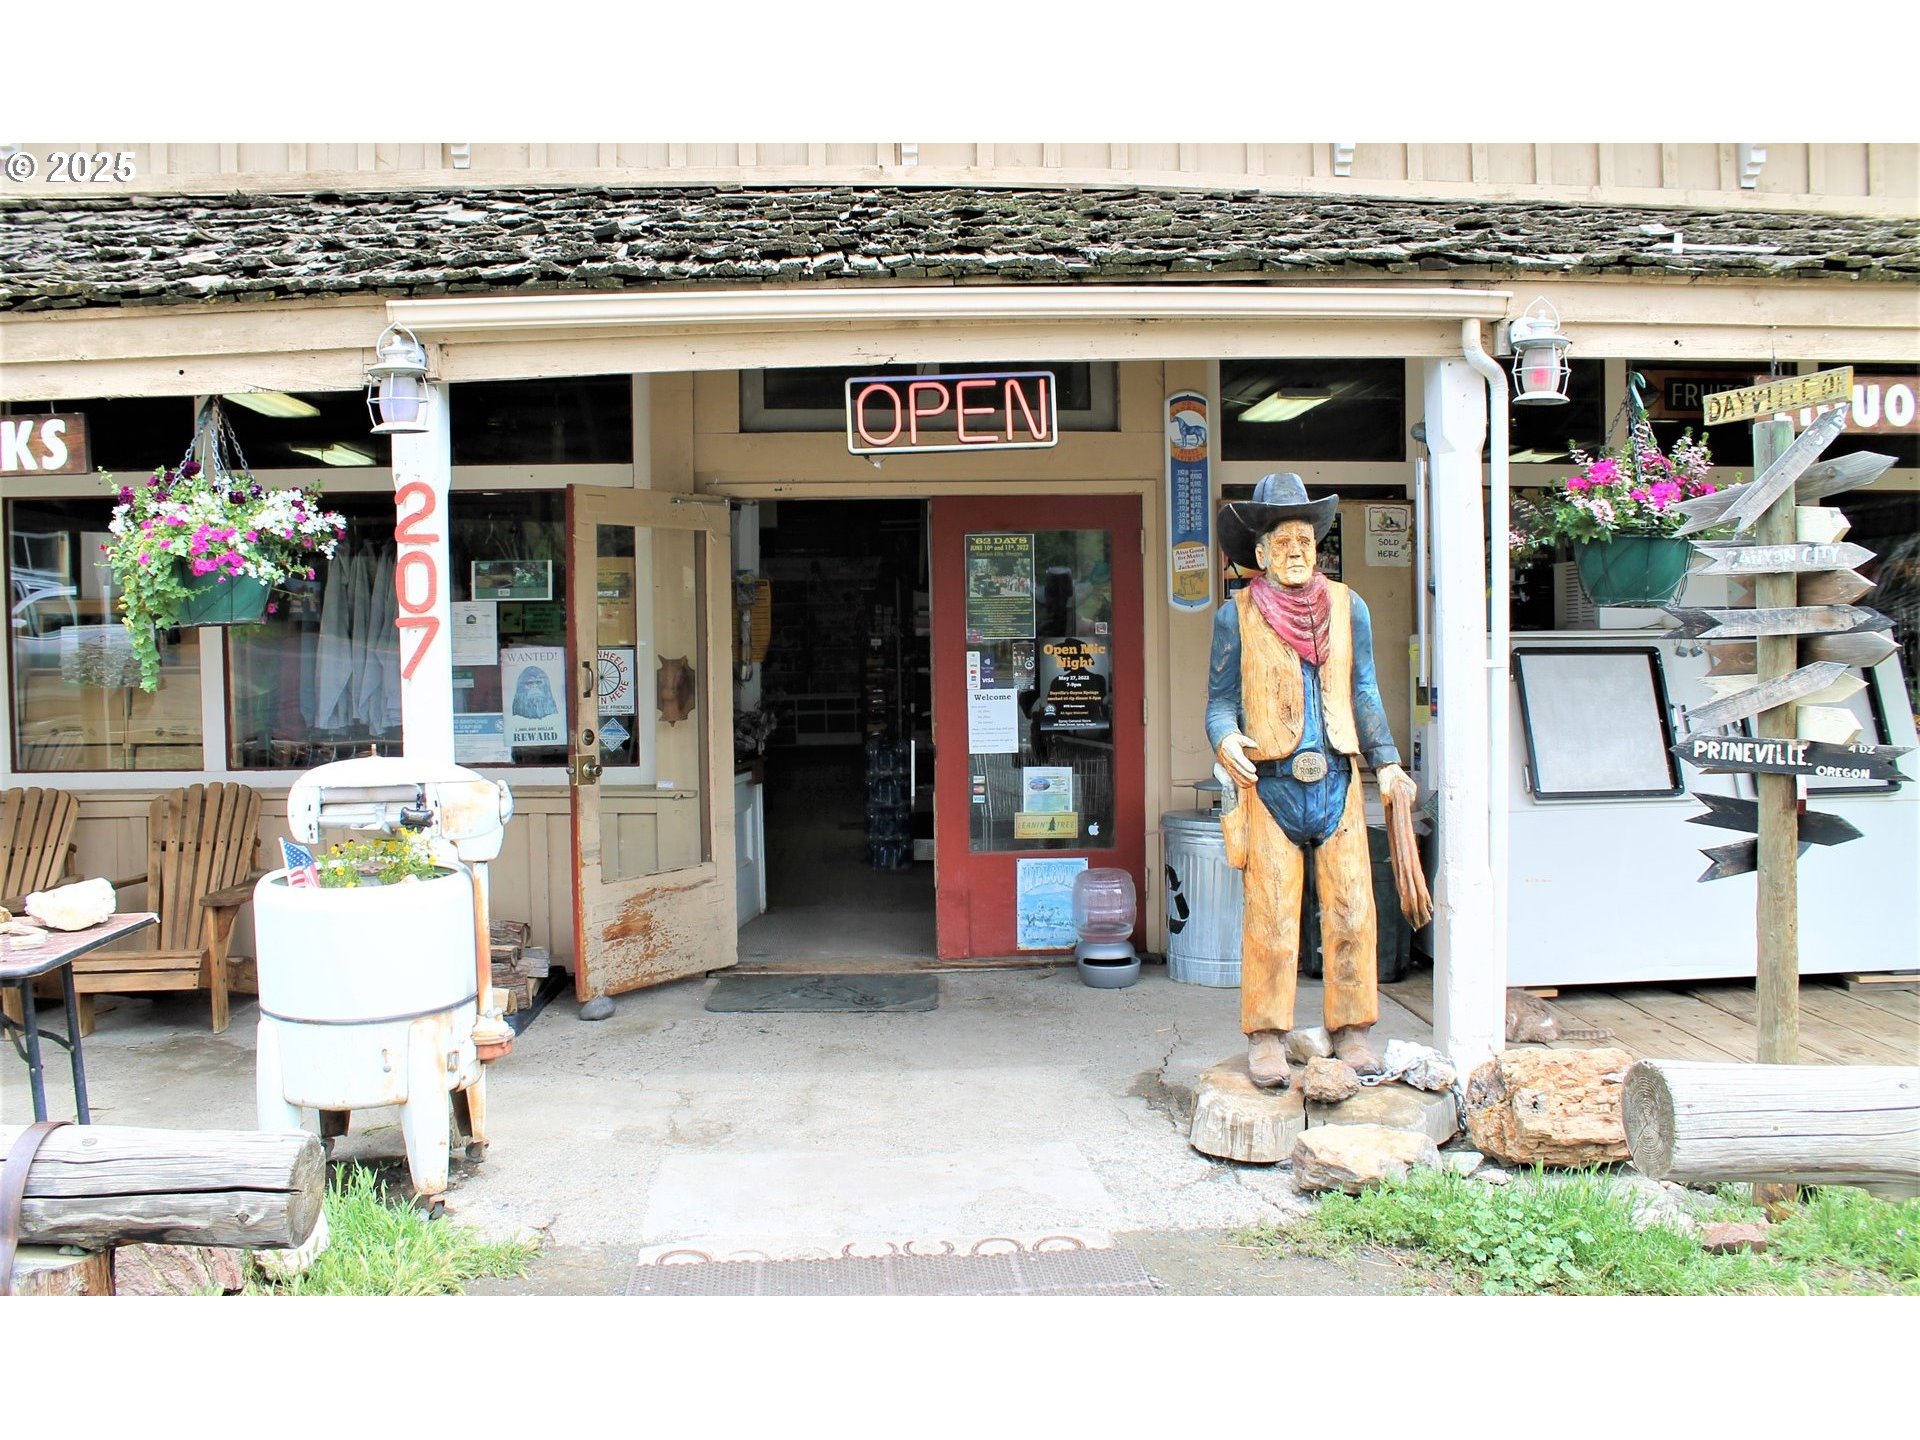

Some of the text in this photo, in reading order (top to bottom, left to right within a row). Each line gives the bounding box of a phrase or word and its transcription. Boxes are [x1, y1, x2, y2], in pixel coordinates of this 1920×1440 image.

[857, 379, 1047, 446] OPEN
[0, 418, 68, 471] KS
[993, 536, 1028, 544] DAYS
[1377, 538, 1400, 546] SOLD
[1377, 550, 1400, 558] HERE
[1802, 545, 1840, 565] CITY
[394, 482, 440, 679] 207
[1043, 643, 1106, 656] Open Mic
[506, 651, 559, 662] WANTED!
[1056, 656, 1094, 670] Night
[609, 680, 629, 702] HERE
[974, 693, 1012, 701] Welcome
[513, 731, 558, 742] REWARD
[1300, 767, 1320, 775] RODEO
[1815, 765, 1871, 779] OREGON
[1057, 821, 1075, 829] TREE
